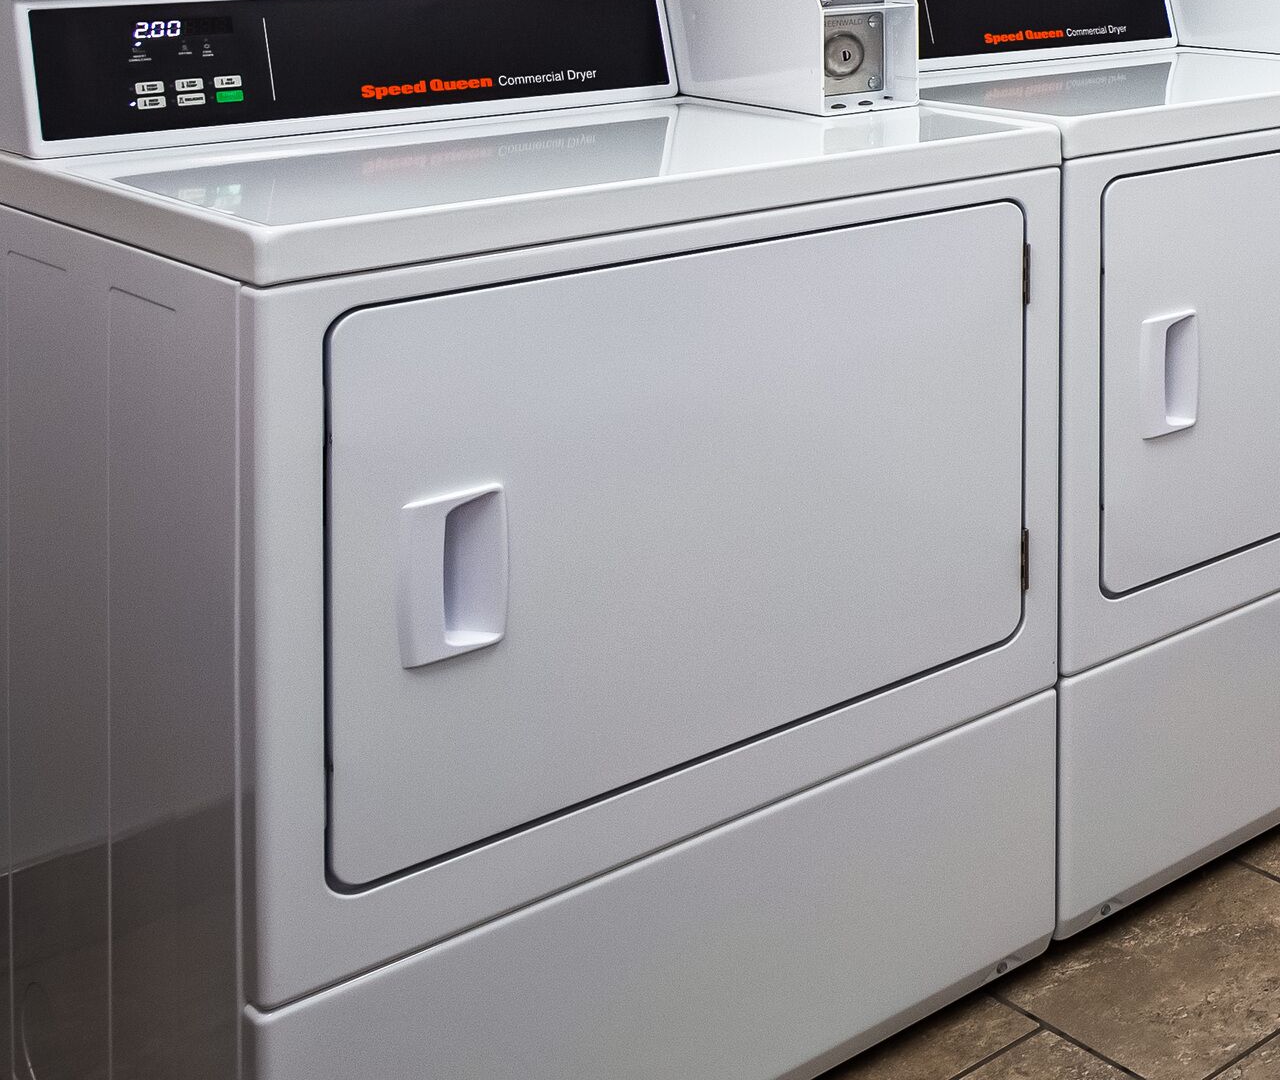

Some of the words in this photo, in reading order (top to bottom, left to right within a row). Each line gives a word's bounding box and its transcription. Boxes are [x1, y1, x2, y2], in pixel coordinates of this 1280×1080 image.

[134, 20, 181, 39] 2.00
[984, 31, 1024, 44] Speed
[1025, 29, 1064, 40] Queen
[1066, 25, 1107, 37] Commercial
[1108, 24, 1127, 34] Dryer
[361, 80, 427, 100] Speed
[430, 77, 493, 92] Queen
[498, 72, 564, 87] Commercial
[567, 69, 597, 82] Dryer
